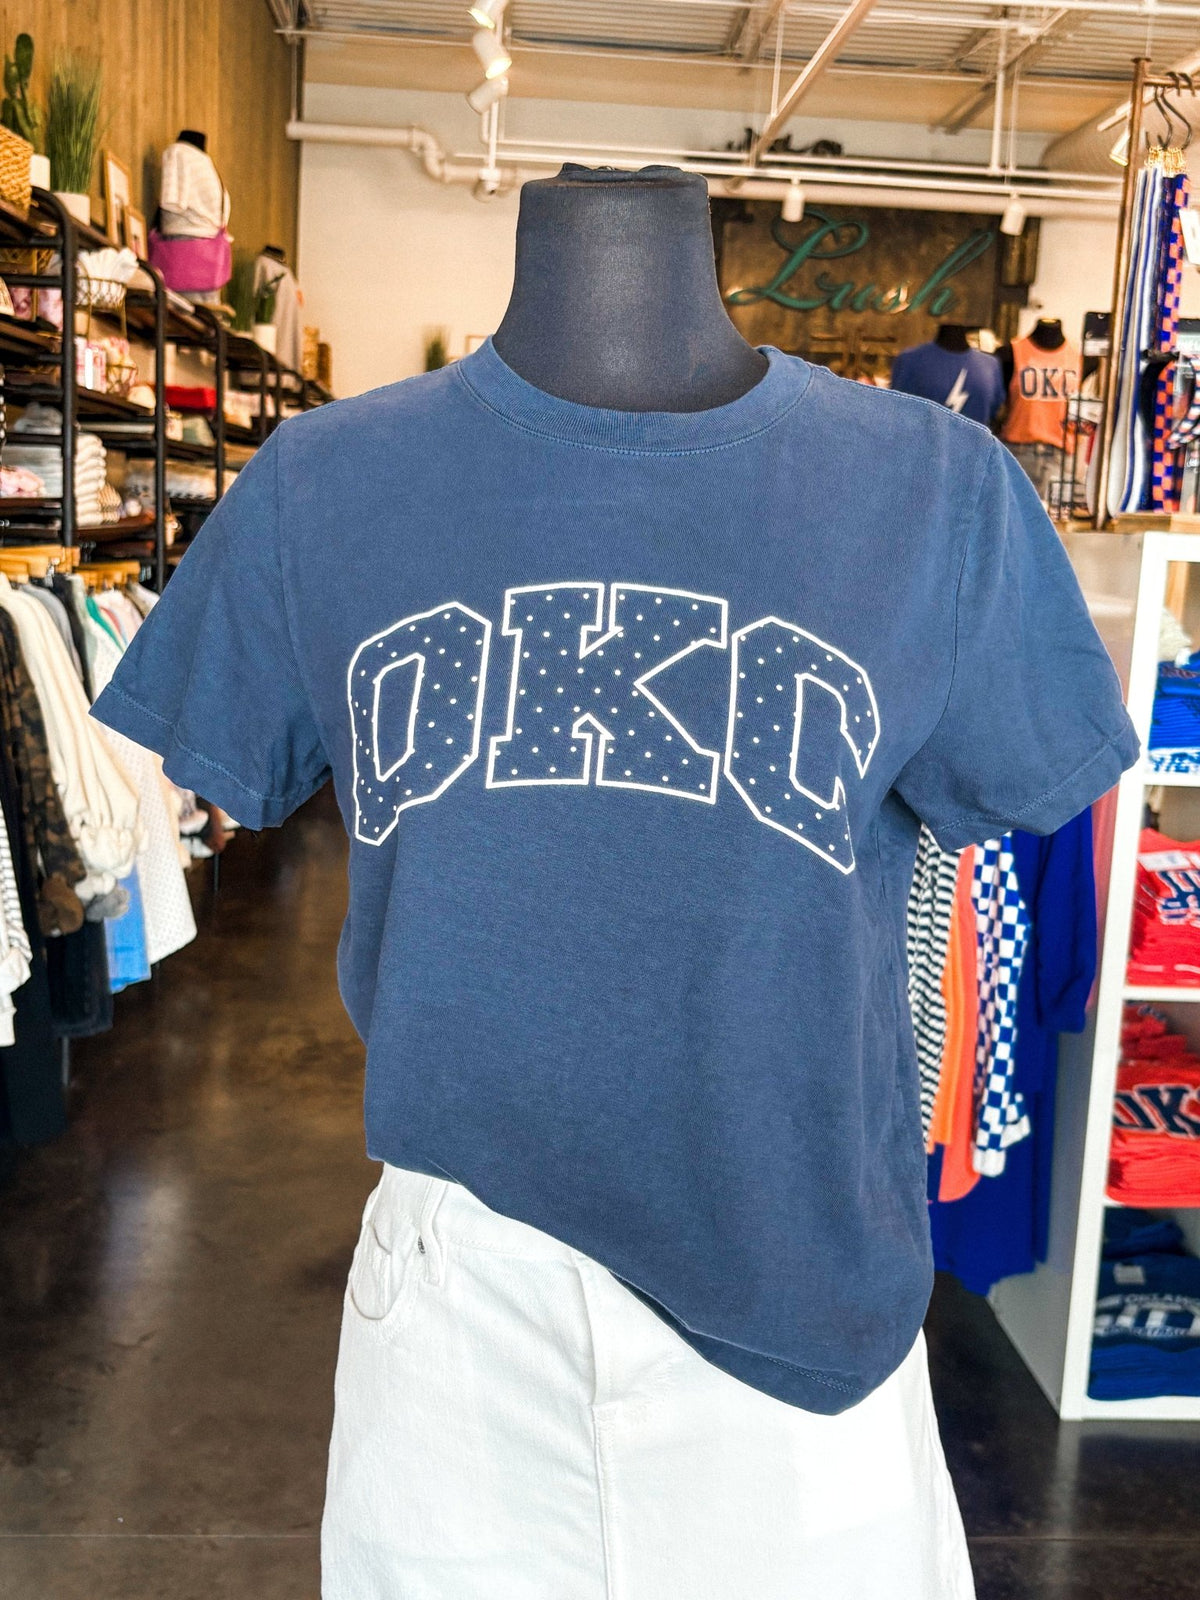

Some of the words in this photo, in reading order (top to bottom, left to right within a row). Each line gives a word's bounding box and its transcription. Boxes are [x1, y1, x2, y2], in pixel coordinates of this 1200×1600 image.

[729, 207, 994, 316] Lush
[1020, 366, 1077, 398] OKC
[347, 581, 880, 873] OKC
[1112, 1083, 1200, 1138] OK
